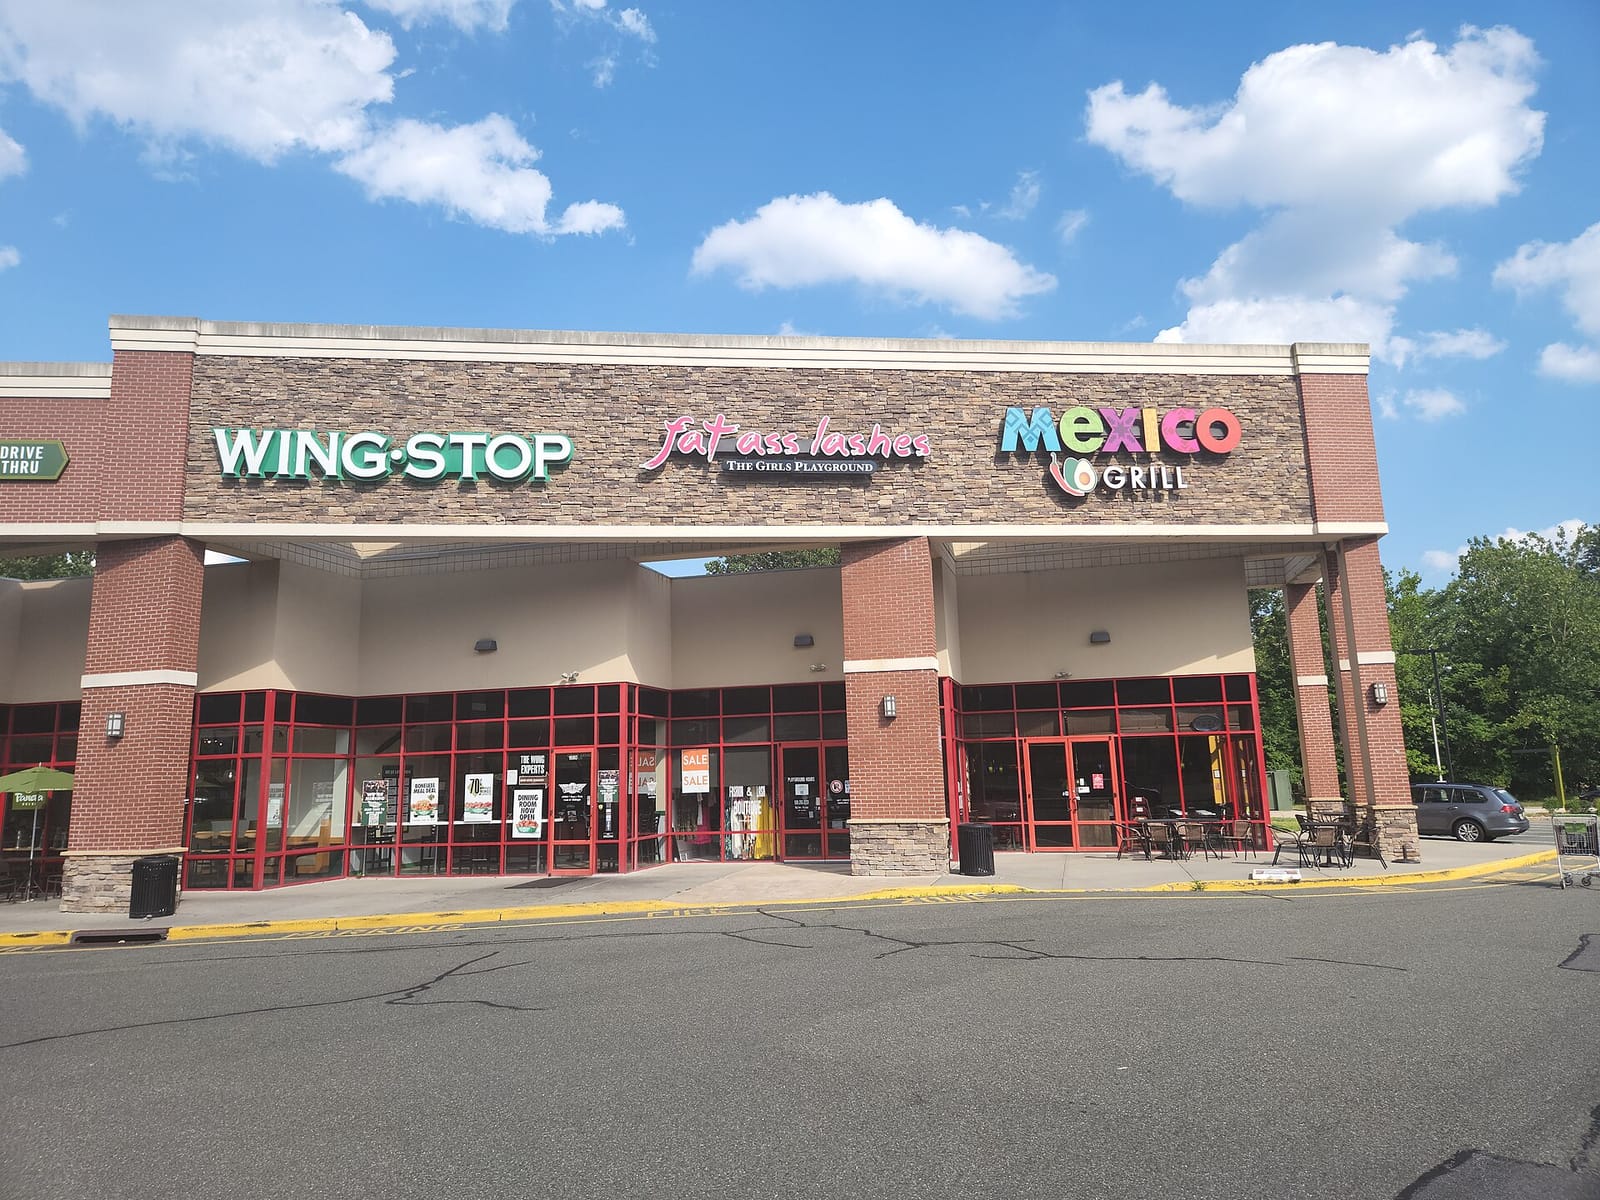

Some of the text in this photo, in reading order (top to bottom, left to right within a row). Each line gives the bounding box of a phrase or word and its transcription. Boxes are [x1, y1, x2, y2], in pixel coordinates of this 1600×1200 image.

[644, 414, 931, 471] fat ass lashes
[0, 445, 44, 460] DRIVE
[1, 460, 40, 474] THRU
[726, 460, 873, 473] THE GIRLS PLAYGROUND
[1102, 465, 1188, 489] GRILL
[683, 754, 708, 766] SALE
[520, 765, 545, 774] EXPERTS
[683, 775, 708, 786] SALE
[746, 786, 753, 797] &
